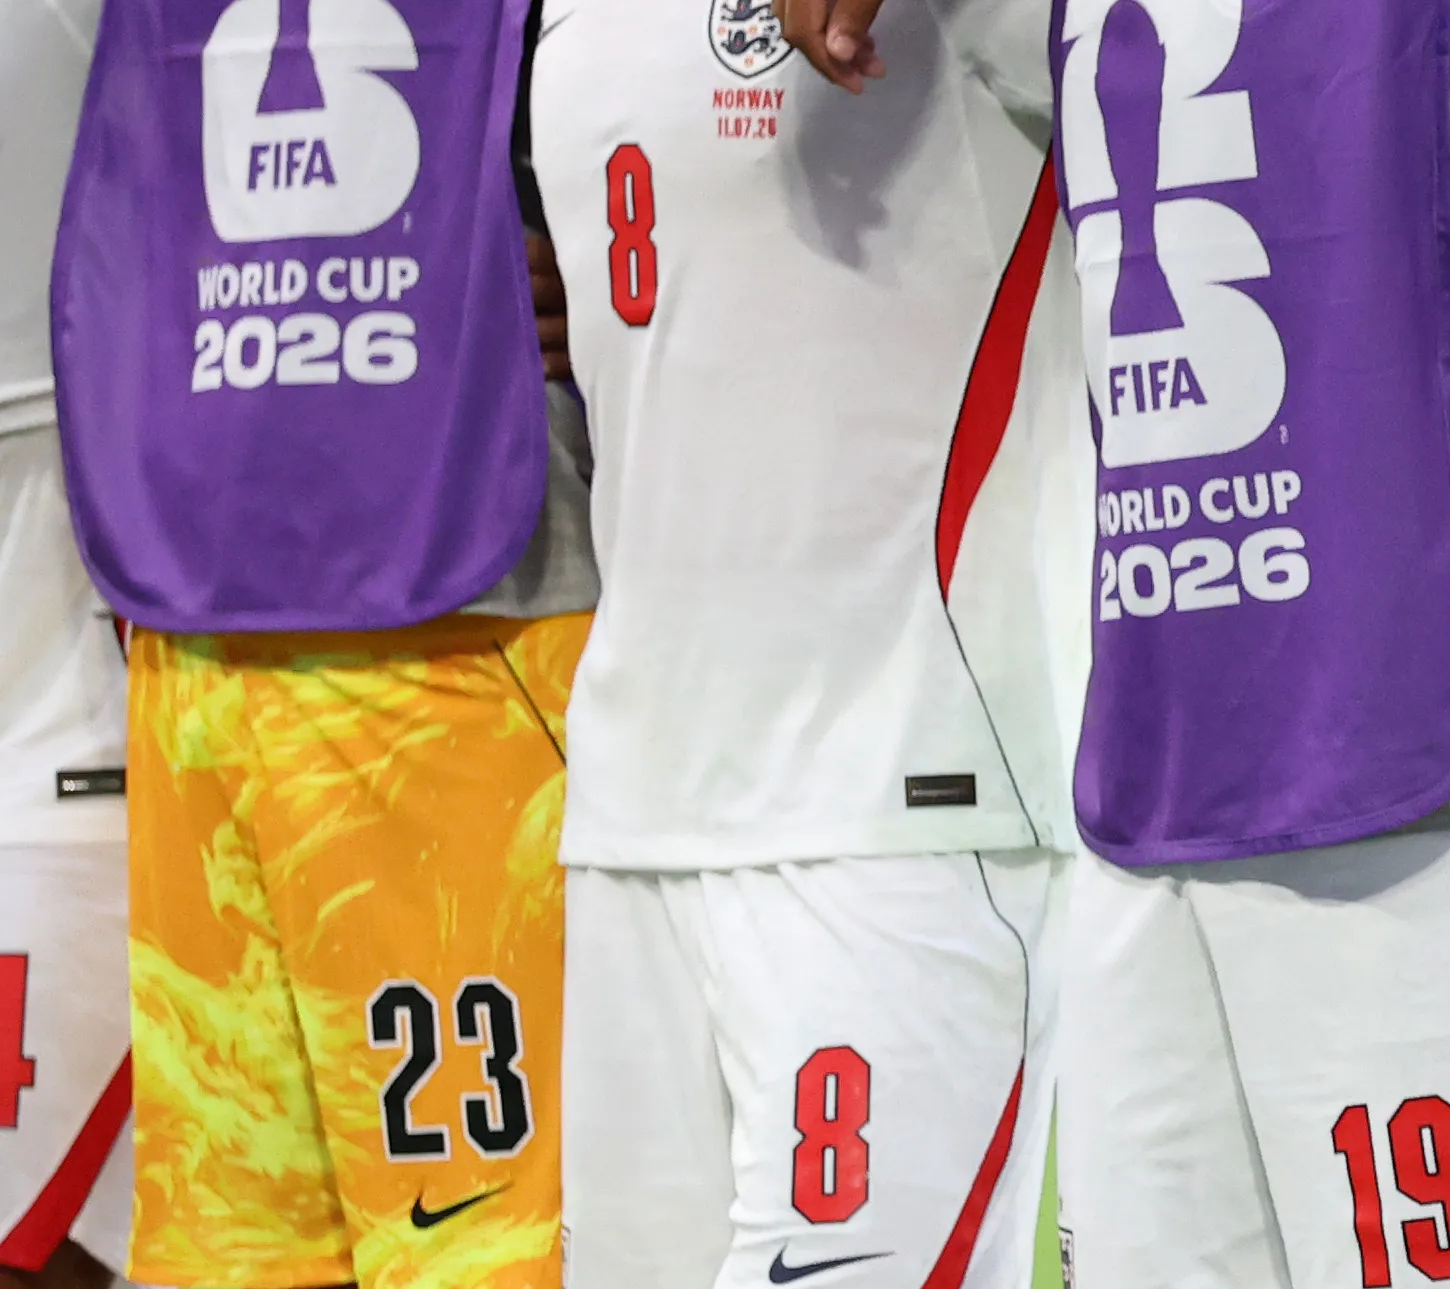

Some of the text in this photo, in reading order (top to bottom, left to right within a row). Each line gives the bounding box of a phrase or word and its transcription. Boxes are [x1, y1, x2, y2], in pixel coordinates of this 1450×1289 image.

[713, 87, 785, 110] NORWAY
[247, 137, 337, 192] FIFA
[606, 144, 659, 327] 8
[198, 257, 421, 310] WORLD CUP
[191, 311, 418, 393] 2026
[1109, 357, 1208, 416] FIFA
[1199, 470, 1301, 523] CUP
[1099, 526, 1310, 622] 2026
[368, 980, 532, 1160] 23
[791, 1044, 872, 1225] 8
